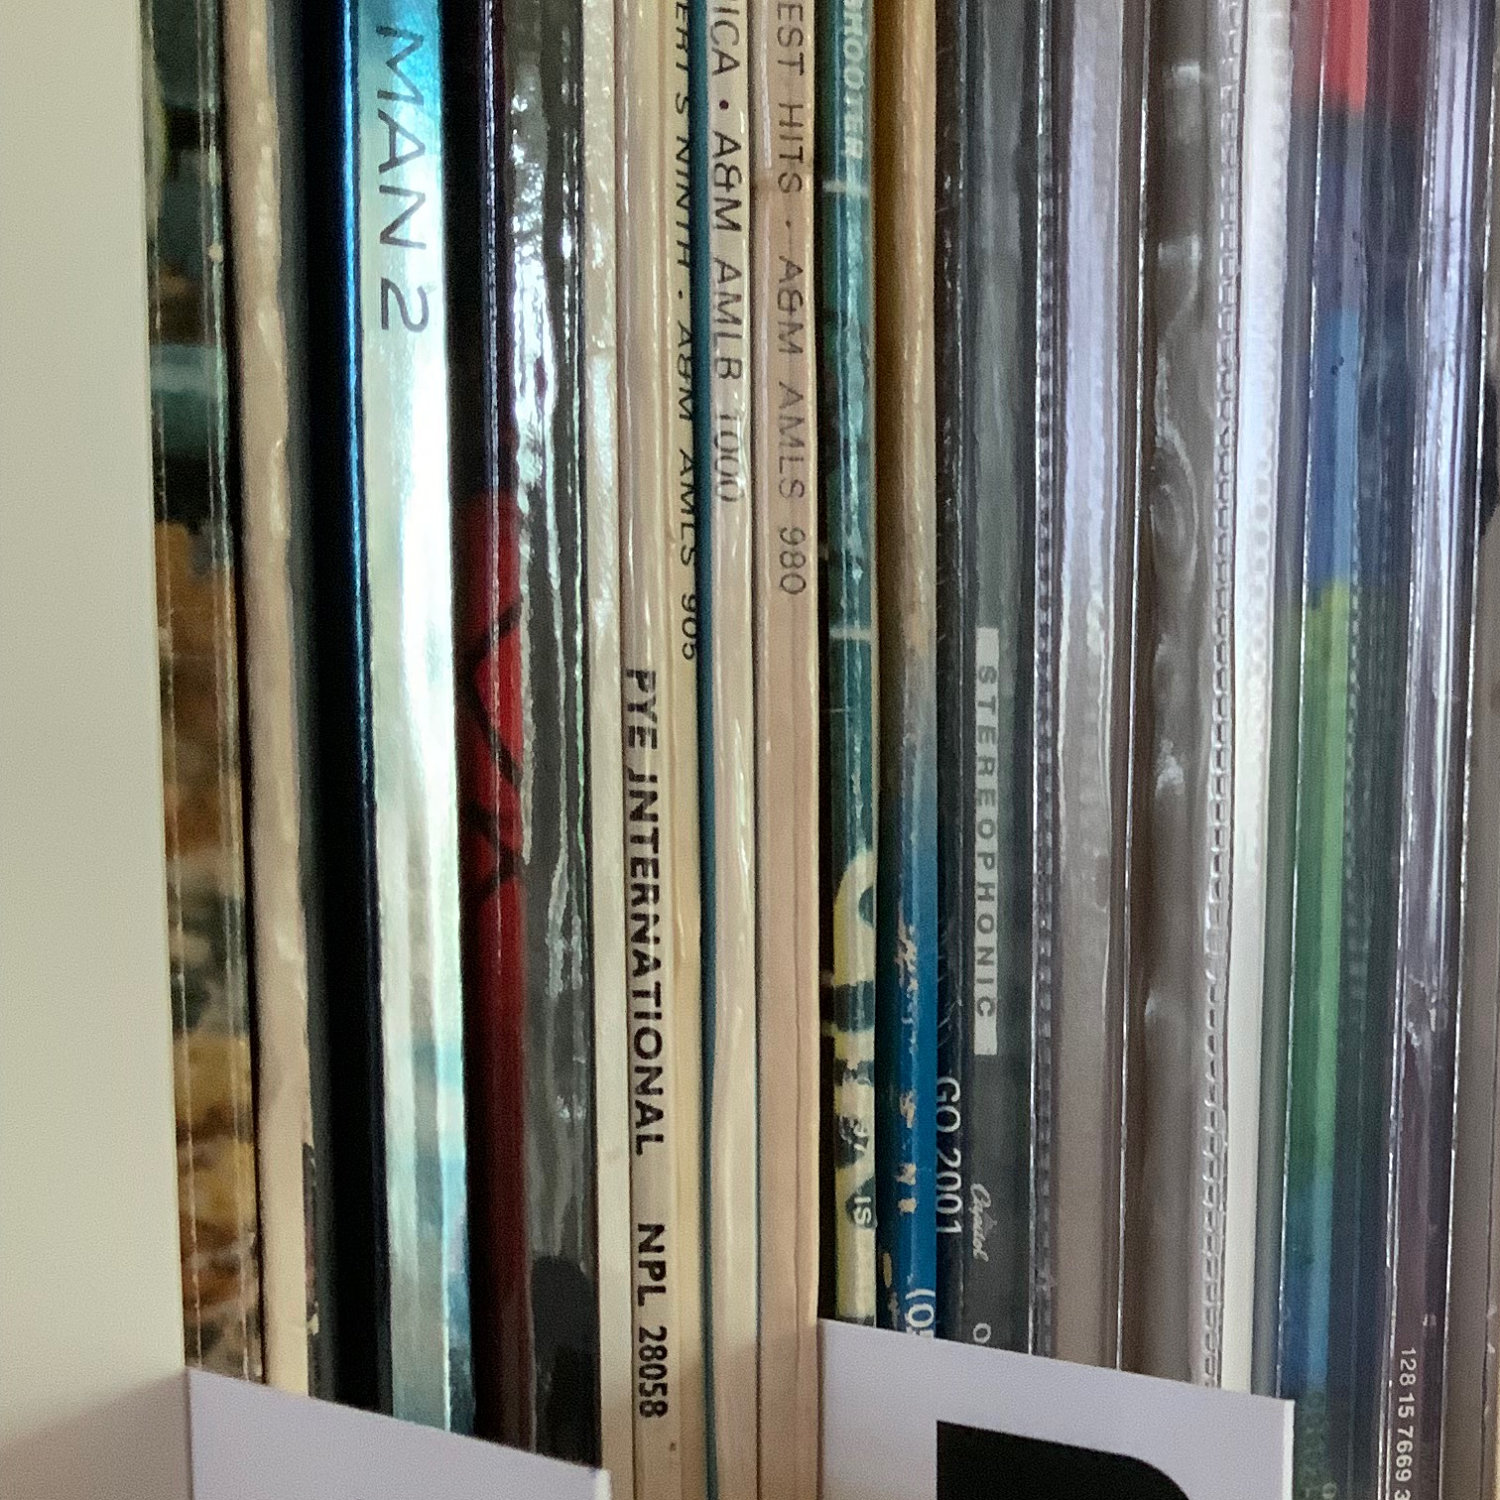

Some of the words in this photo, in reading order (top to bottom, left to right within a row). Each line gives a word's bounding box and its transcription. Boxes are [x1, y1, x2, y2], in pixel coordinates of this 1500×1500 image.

[375, 26, 426, 250] MAN
[711, 131, 741, 231] A&M
[778, 103, 804, 194] HITS
[380, 279, 428, 332] 2
[711, 257, 743, 380] AMLB
[777, 256, 804, 355] A&M
[713, 410, 743, 502] 1000
[777, 382, 804, 499] AMLS
[778, 526, 806, 595] 980
[626, 668, 658, 748] PYE
[975, 664, 998, 1019] STEREOPHONIC
[627, 771, 664, 1155] INTERNATIONAL
[936, 1076, 961, 1132] GO
[936, 1147, 962, 1235] 2001
[969, 1183, 991, 1262] Capitol
[635, 1223, 666, 1305] NPL
[638, 1326, 667, 1418] 28058
[1398, 1393, 1414, 1418] 15
[1400, 1347, 1416, 1385] 128
[1395, 1425, 1413, 1482] 7669
